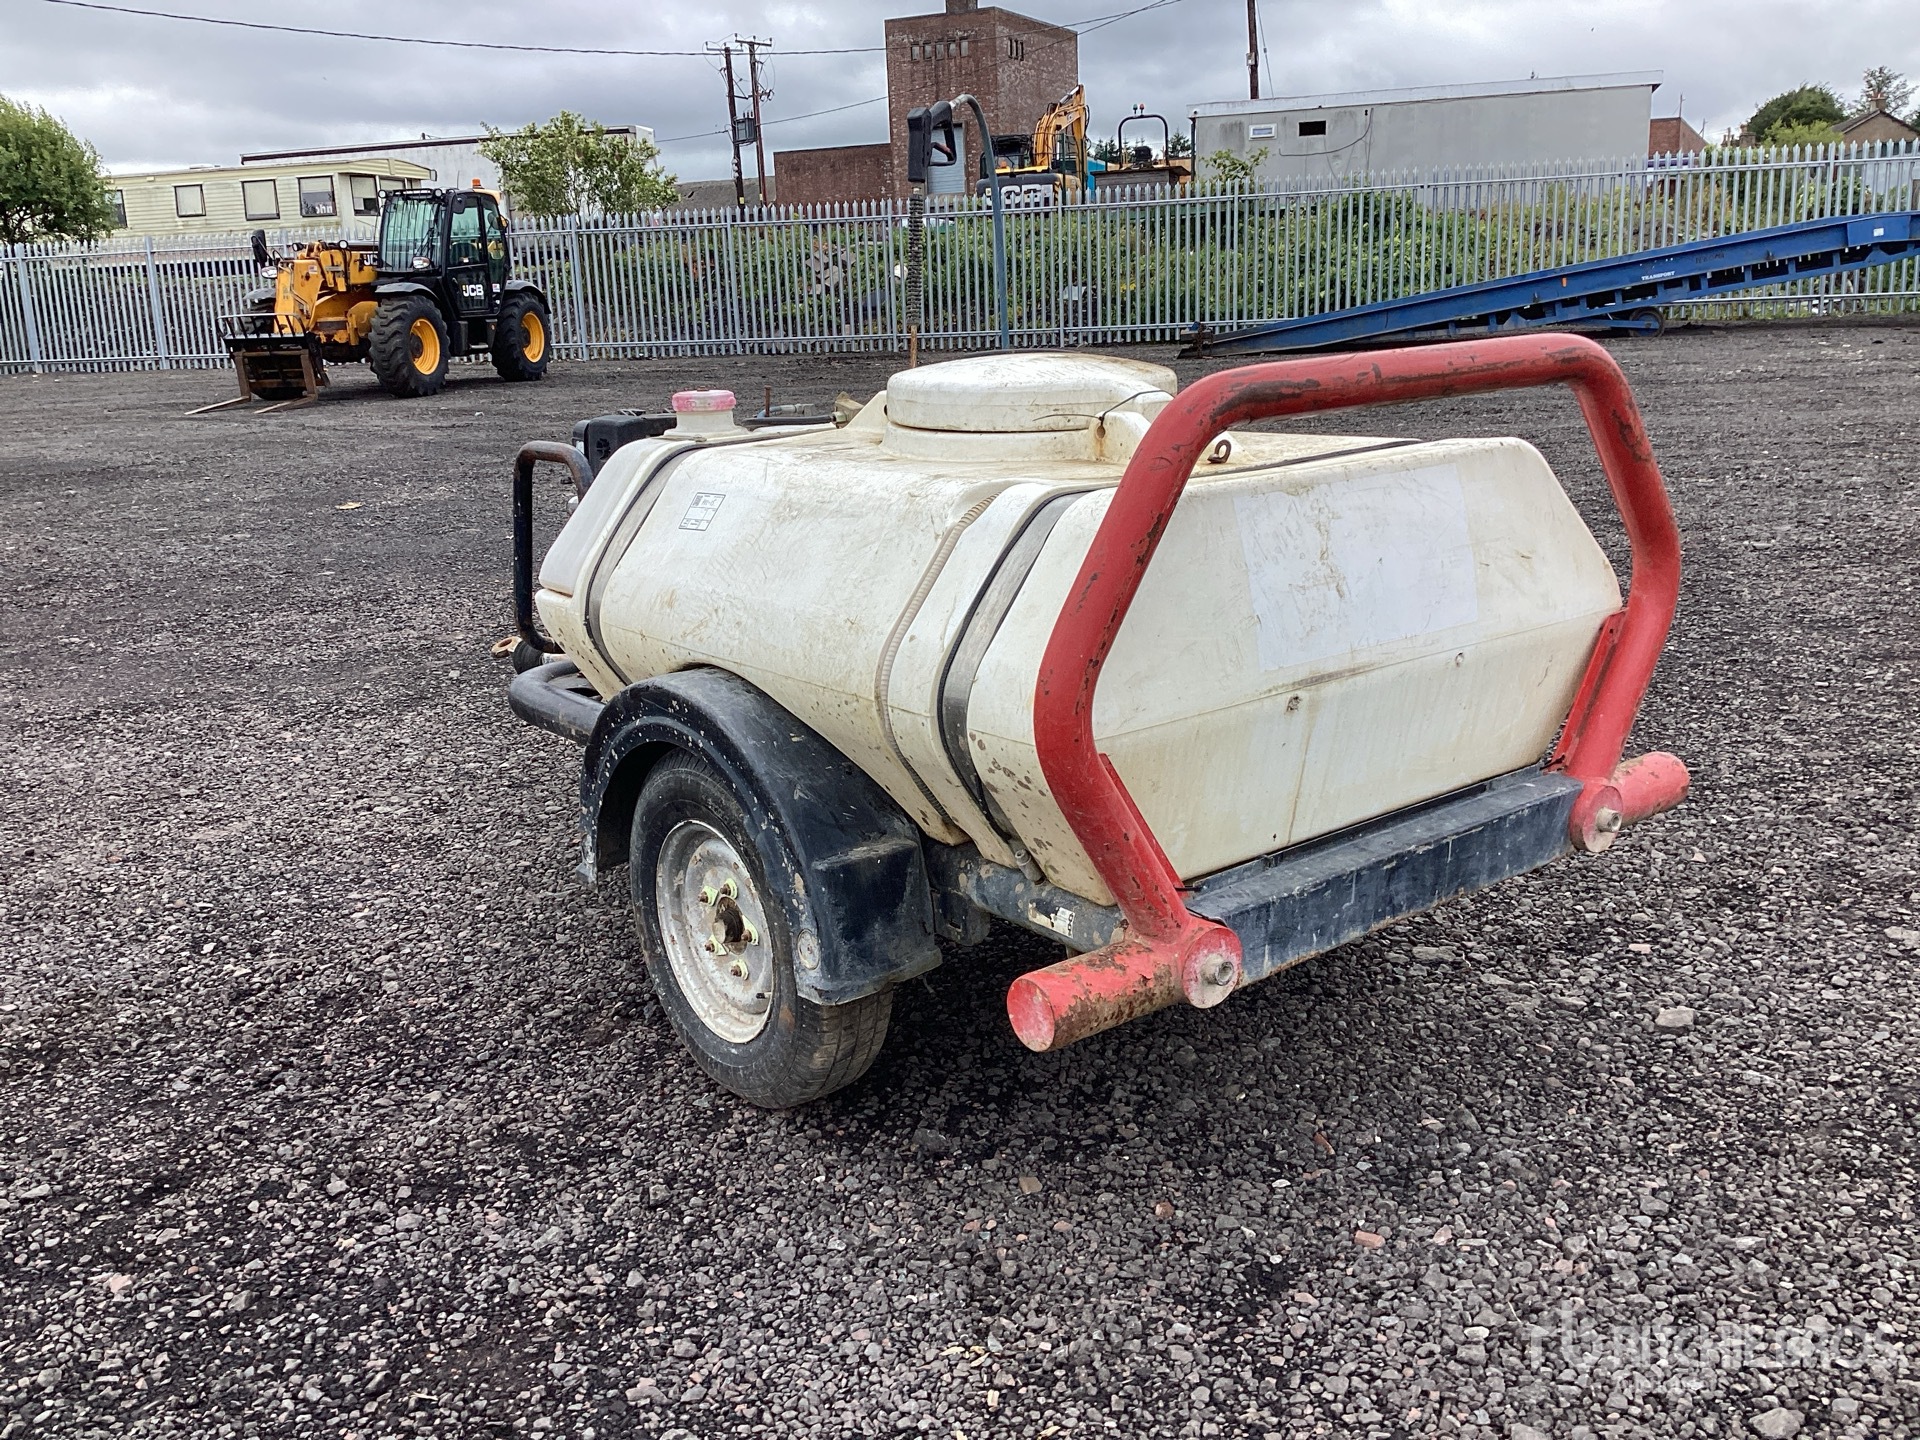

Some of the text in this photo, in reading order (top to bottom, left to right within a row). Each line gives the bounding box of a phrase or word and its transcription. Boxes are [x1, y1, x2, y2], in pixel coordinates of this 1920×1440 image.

[363, 254, 378, 266] JC
[1641, 271, 1676, 281] TRANSPORT
[462, 284, 484, 297] JCB
